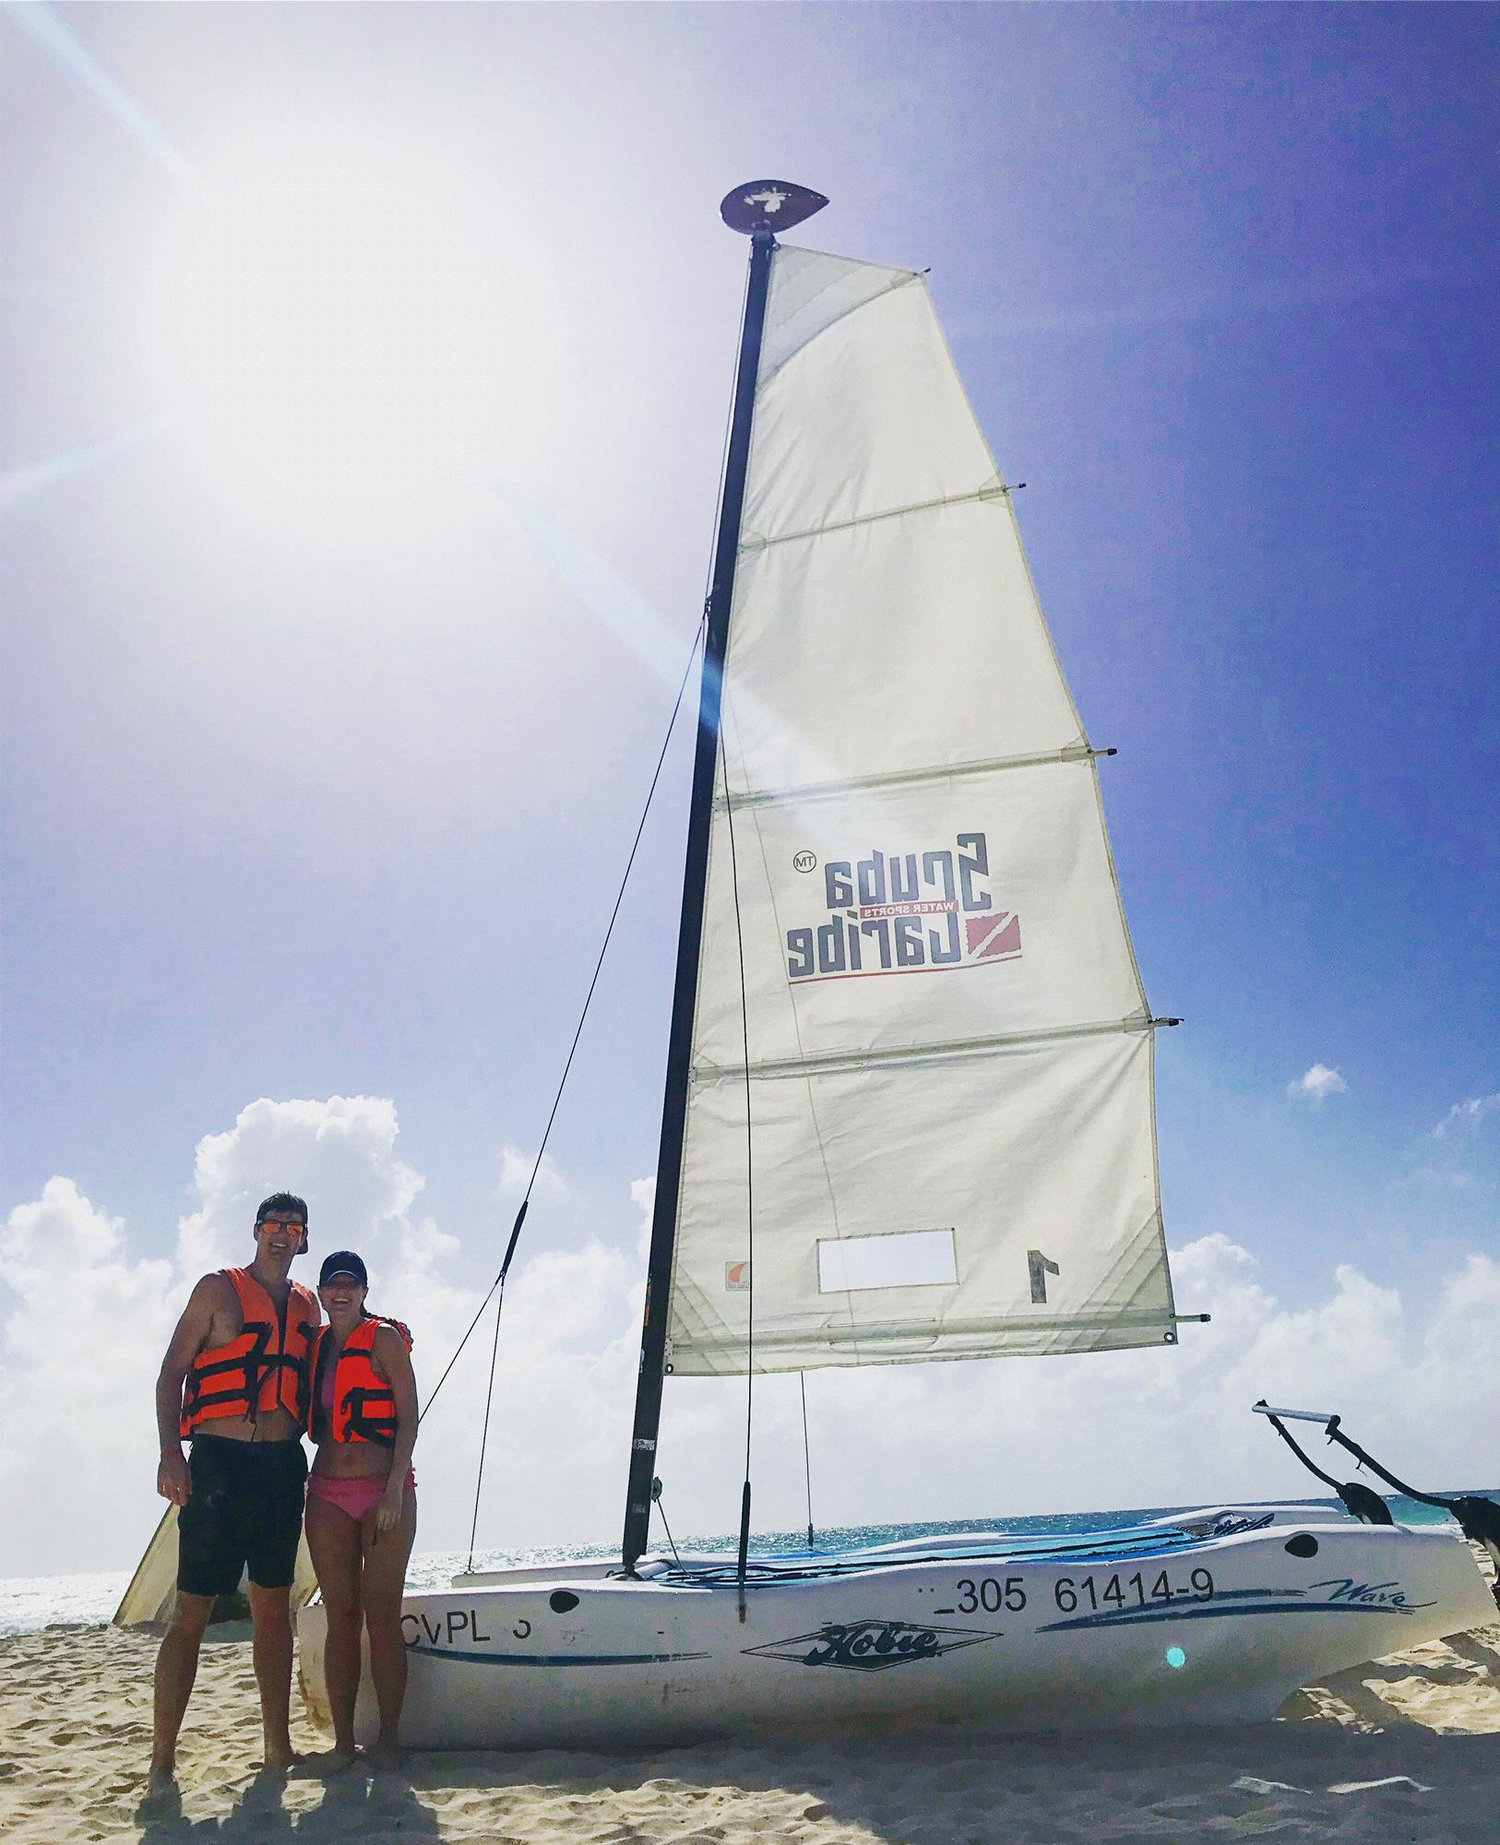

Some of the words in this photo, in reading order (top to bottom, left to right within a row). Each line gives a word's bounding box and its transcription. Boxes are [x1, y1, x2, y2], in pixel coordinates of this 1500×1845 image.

[1054, 1567, 1214, 1614] 61414-9
[1308, 1578, 1438, 1608] Wave
[803, 1622, 941, 1667] Hobie
